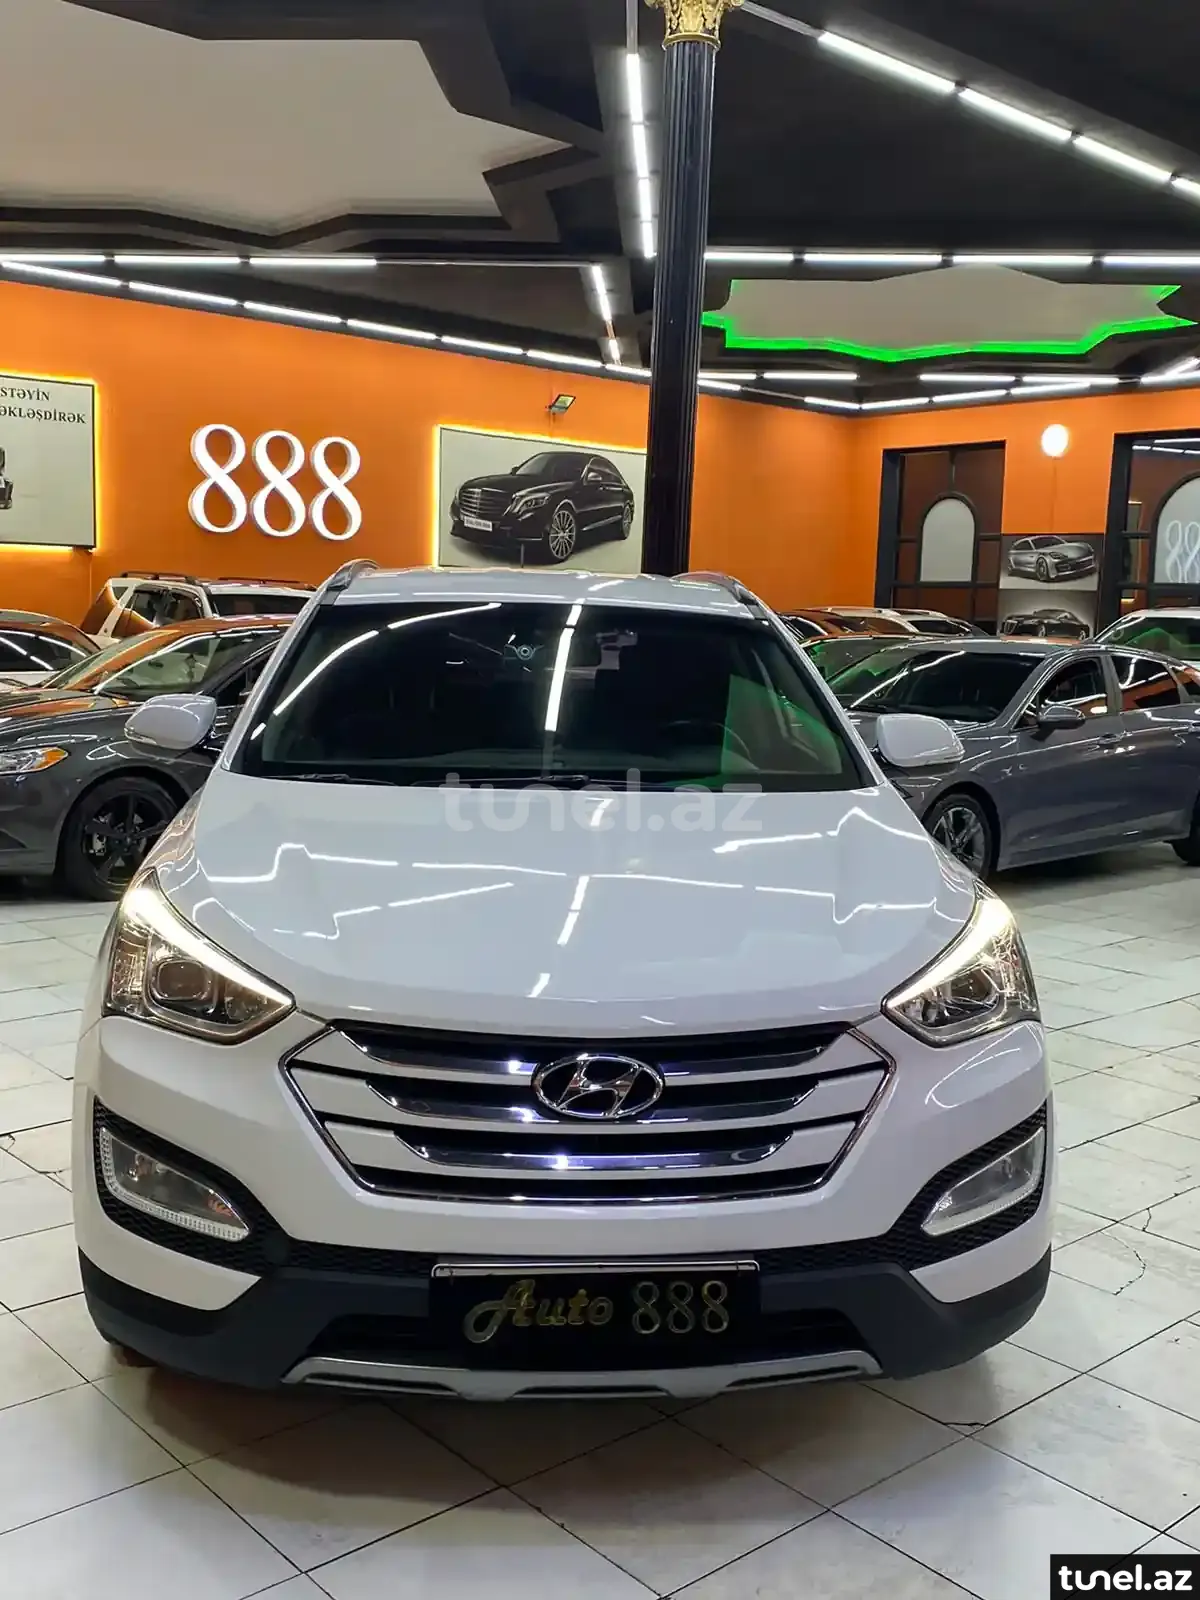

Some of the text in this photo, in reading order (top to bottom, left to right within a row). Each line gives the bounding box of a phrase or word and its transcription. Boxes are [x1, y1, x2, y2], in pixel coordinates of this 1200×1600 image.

[188, 423, 362, 541] 888
[463, 1279, 729, 1343] Auto 888
